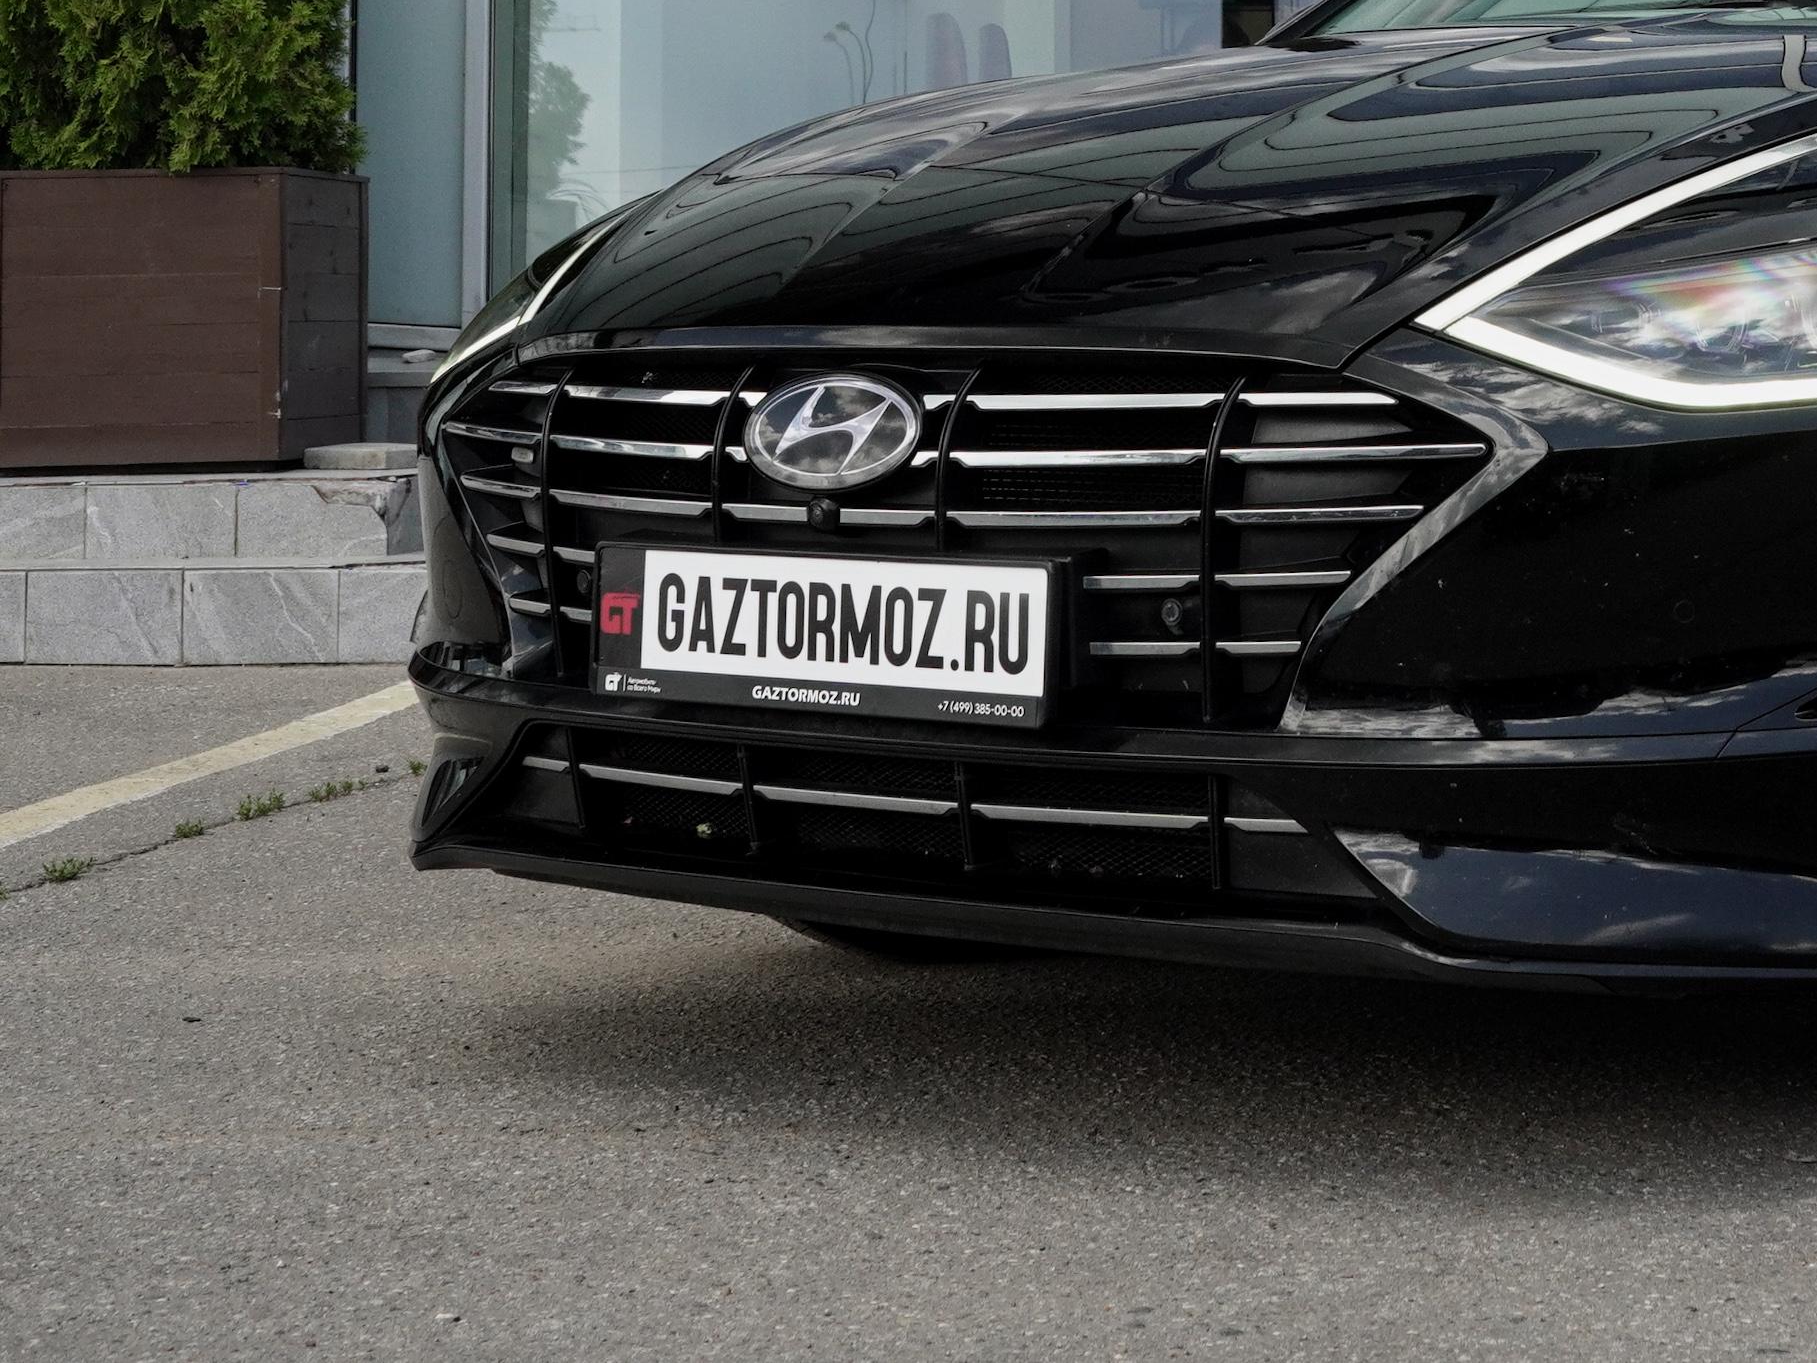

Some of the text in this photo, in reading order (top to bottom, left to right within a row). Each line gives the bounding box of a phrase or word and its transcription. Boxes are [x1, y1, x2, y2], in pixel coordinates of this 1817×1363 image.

[656, 572, 1030, 675] GAZTORMOZ.RU
[751, 685, 861, 707] GAZTORMOZ.RU
[937, 701, 1025, 717] +7 (499) 385-00-00
